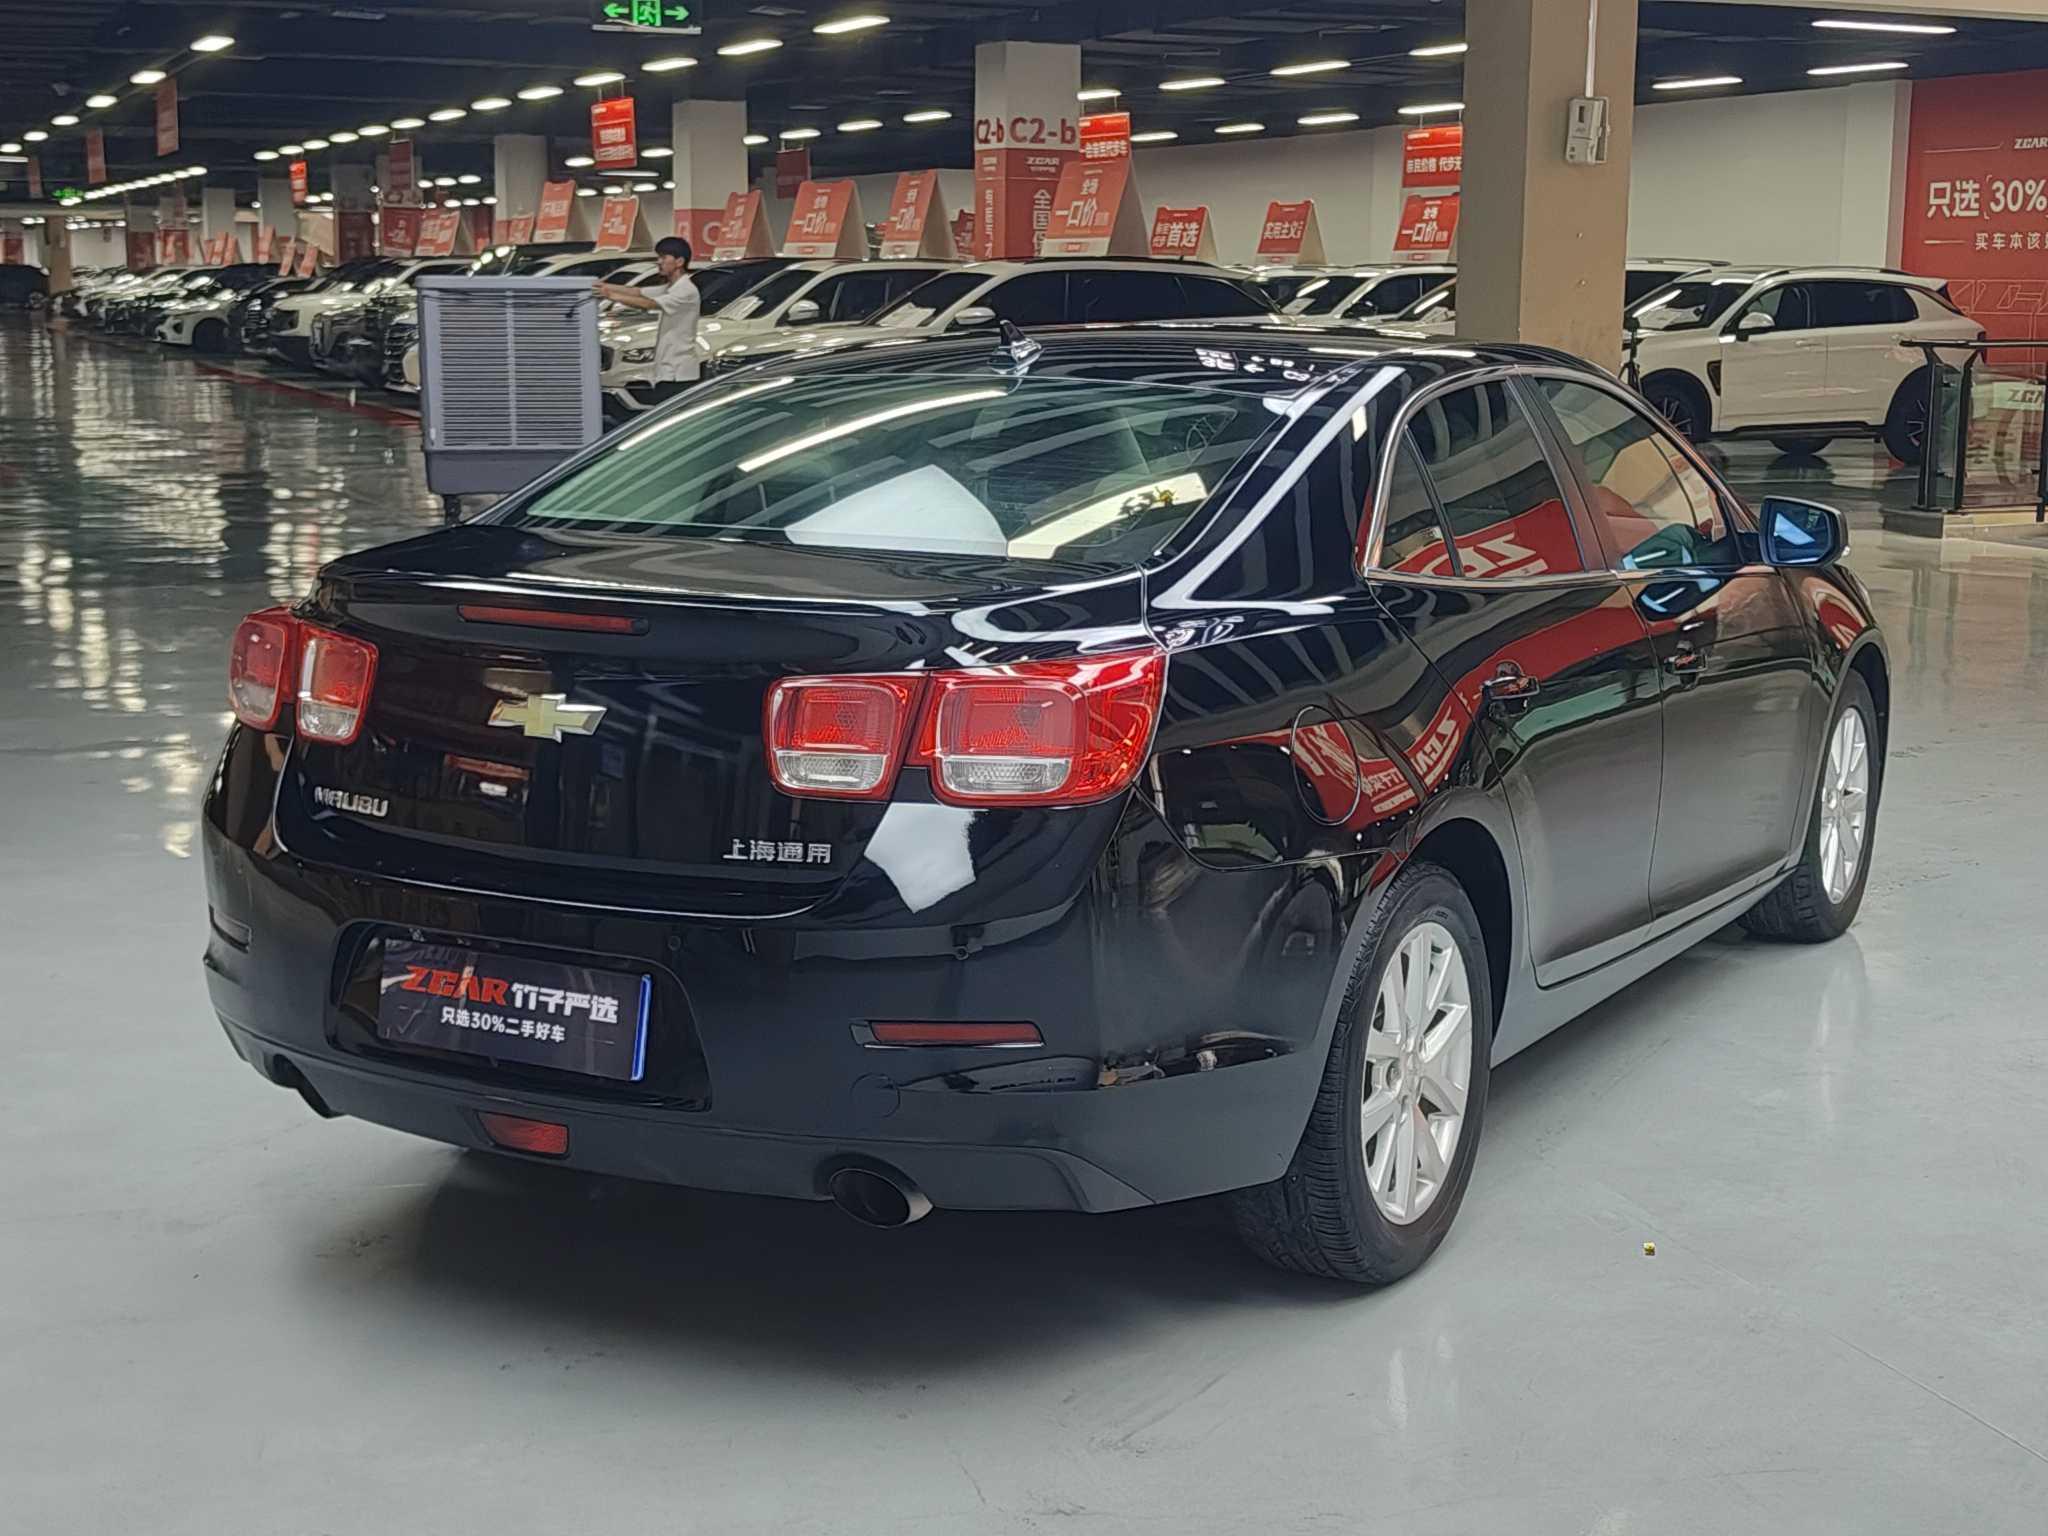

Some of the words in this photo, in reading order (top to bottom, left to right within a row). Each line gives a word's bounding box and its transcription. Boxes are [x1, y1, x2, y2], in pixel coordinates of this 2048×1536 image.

[976, 117, 1004, 144] C2-b
[1009, 117, 1077, 145] C2-b
[1055, 197, 1098, 227] 一口价
[1167, 221, 1200, 248] 首选
[1401, 220, 1439, 243] 一口价
[722, 838, 832, 864] 上海通用
[400, 964, 509, 1007] ZCAR
[440, 1005, 567, 1044] 只选30%二手好车
